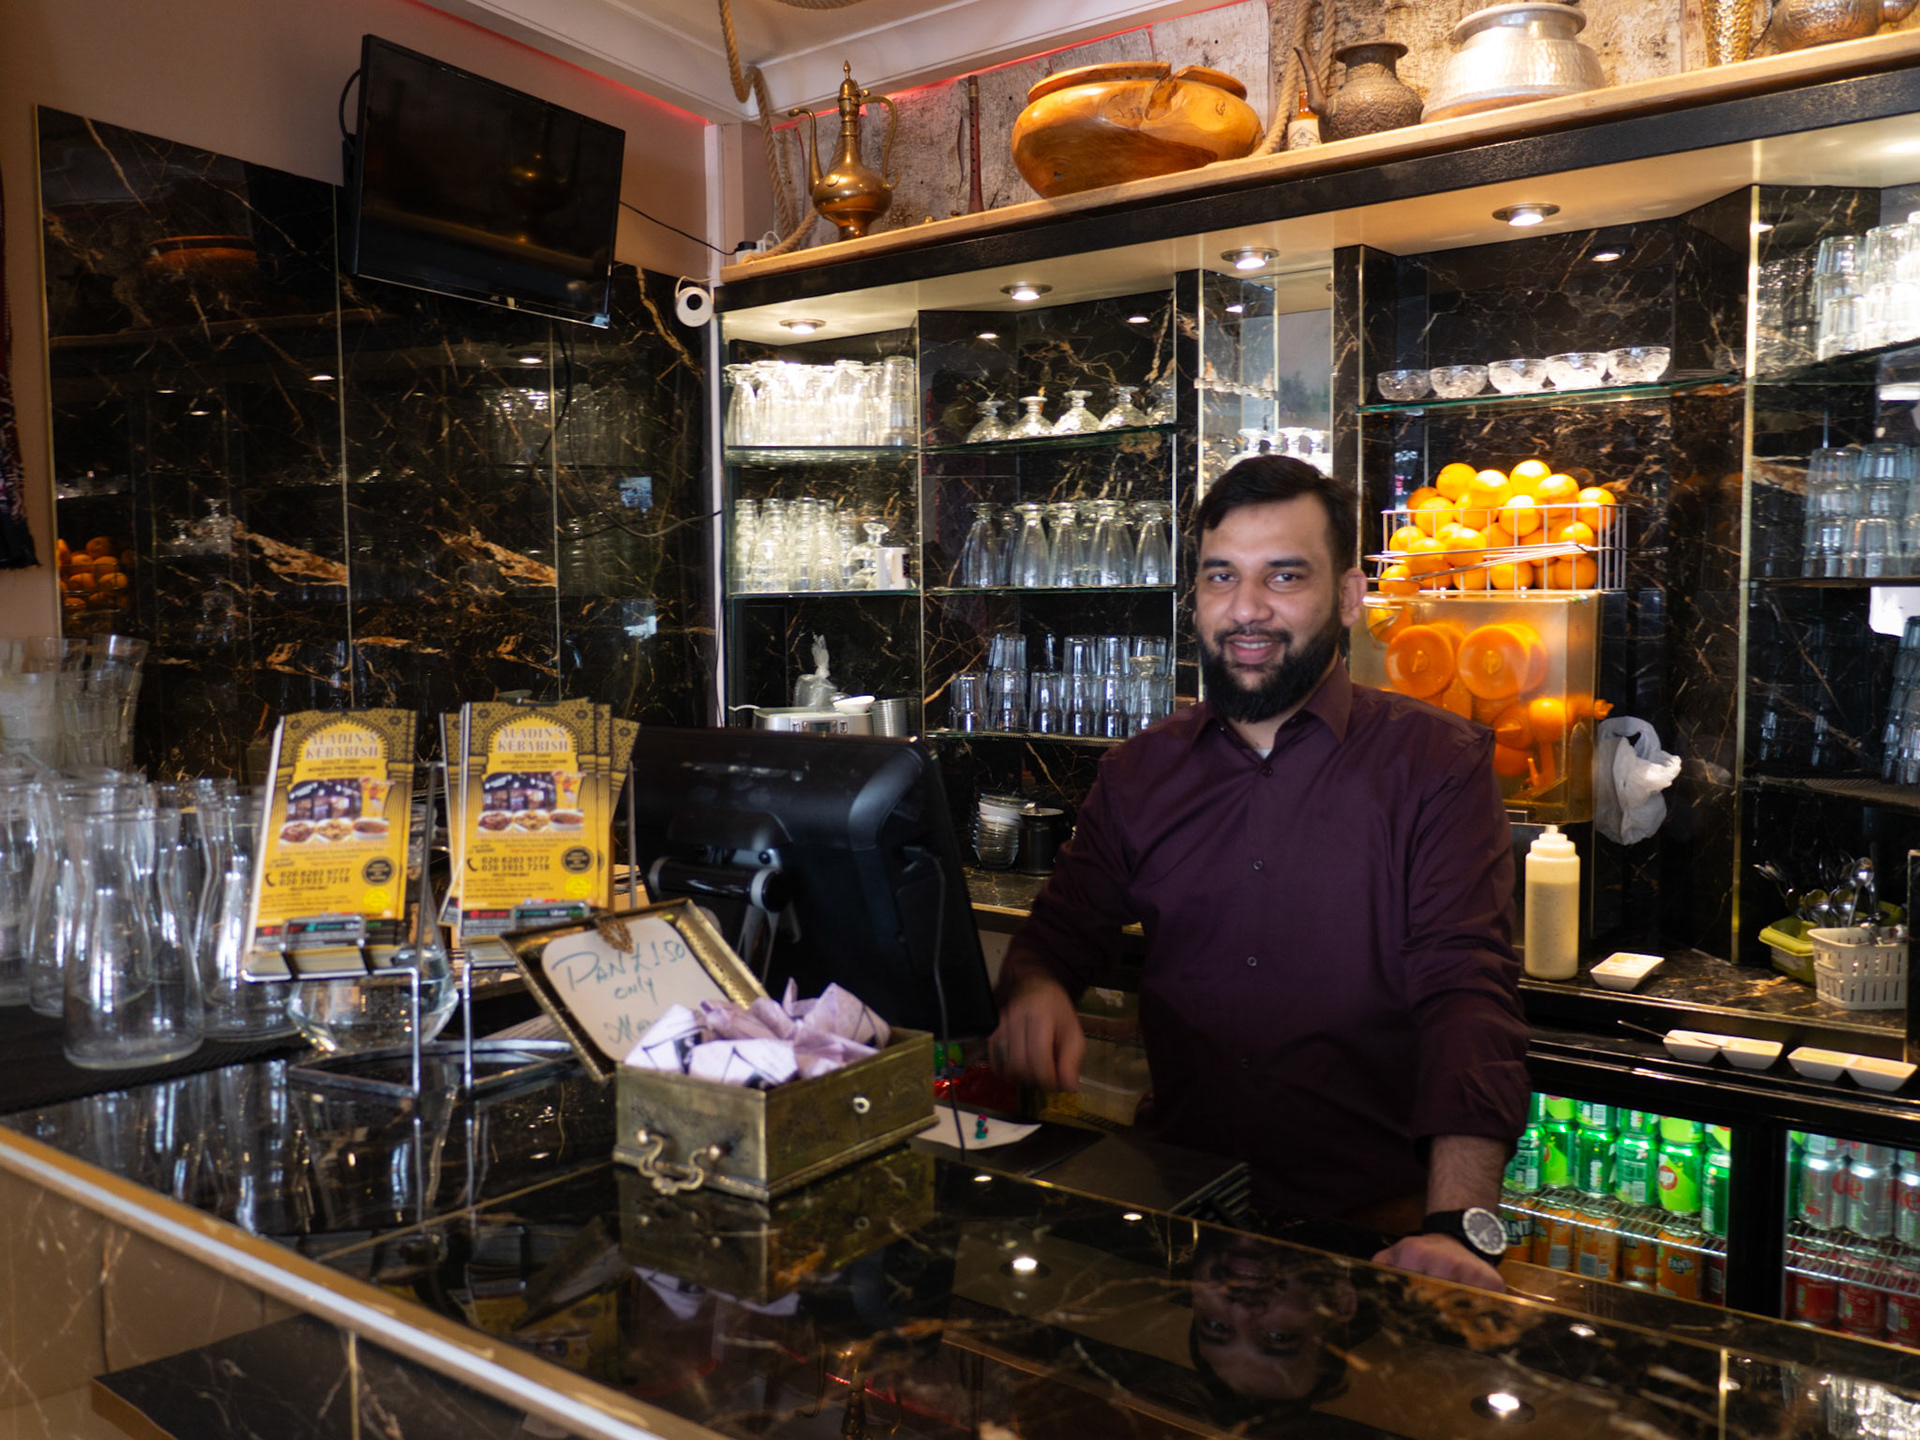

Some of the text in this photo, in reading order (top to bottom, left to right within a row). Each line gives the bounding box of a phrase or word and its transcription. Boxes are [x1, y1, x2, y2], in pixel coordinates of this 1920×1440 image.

[311, 730, 378, 746] ALADIN'S
[501, 727, 567, 740] ALADIN'S
[305, 746, 379, 760] KEBABISH
[497, 740, 569, 753] KEBABISH
